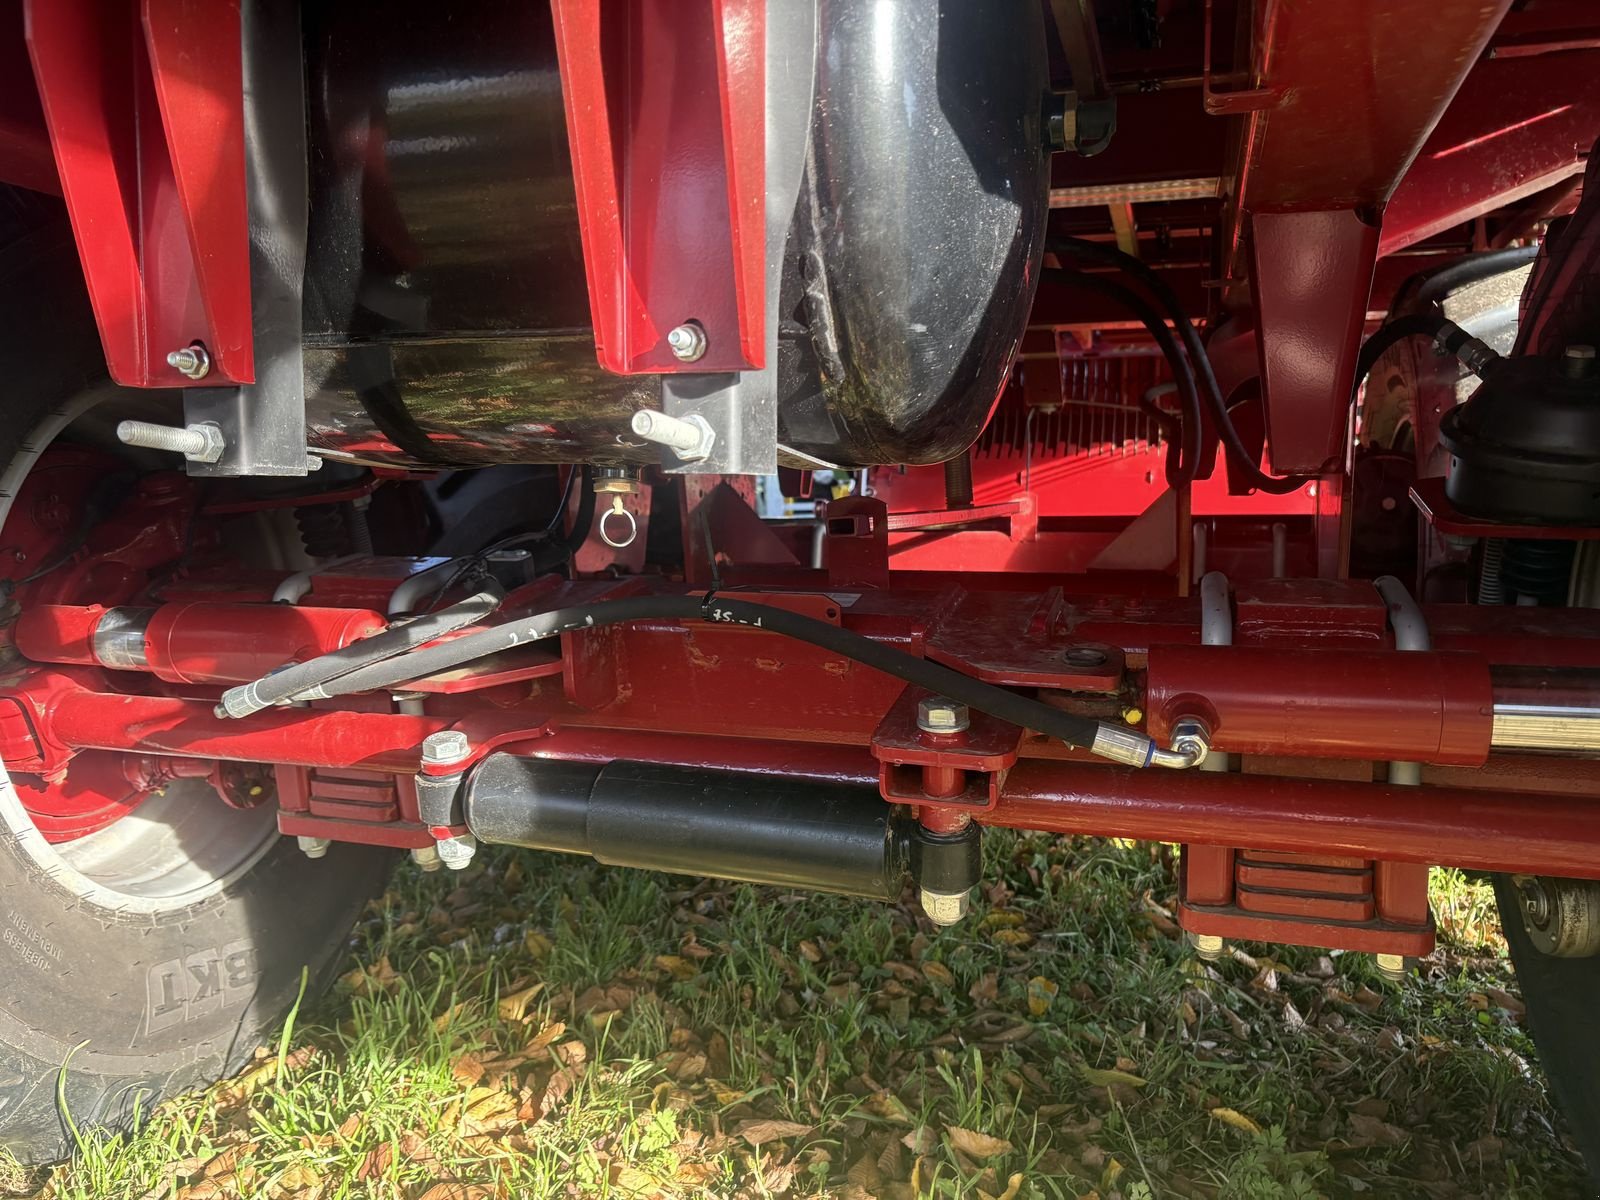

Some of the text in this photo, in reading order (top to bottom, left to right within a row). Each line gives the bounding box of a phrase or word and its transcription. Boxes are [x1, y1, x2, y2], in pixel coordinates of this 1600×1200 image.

[4, 928, 51, 972] TUBELESS
[8, 910, 64, 961] IMPLEMENT
[150, 942, 257, 1016] BKT
